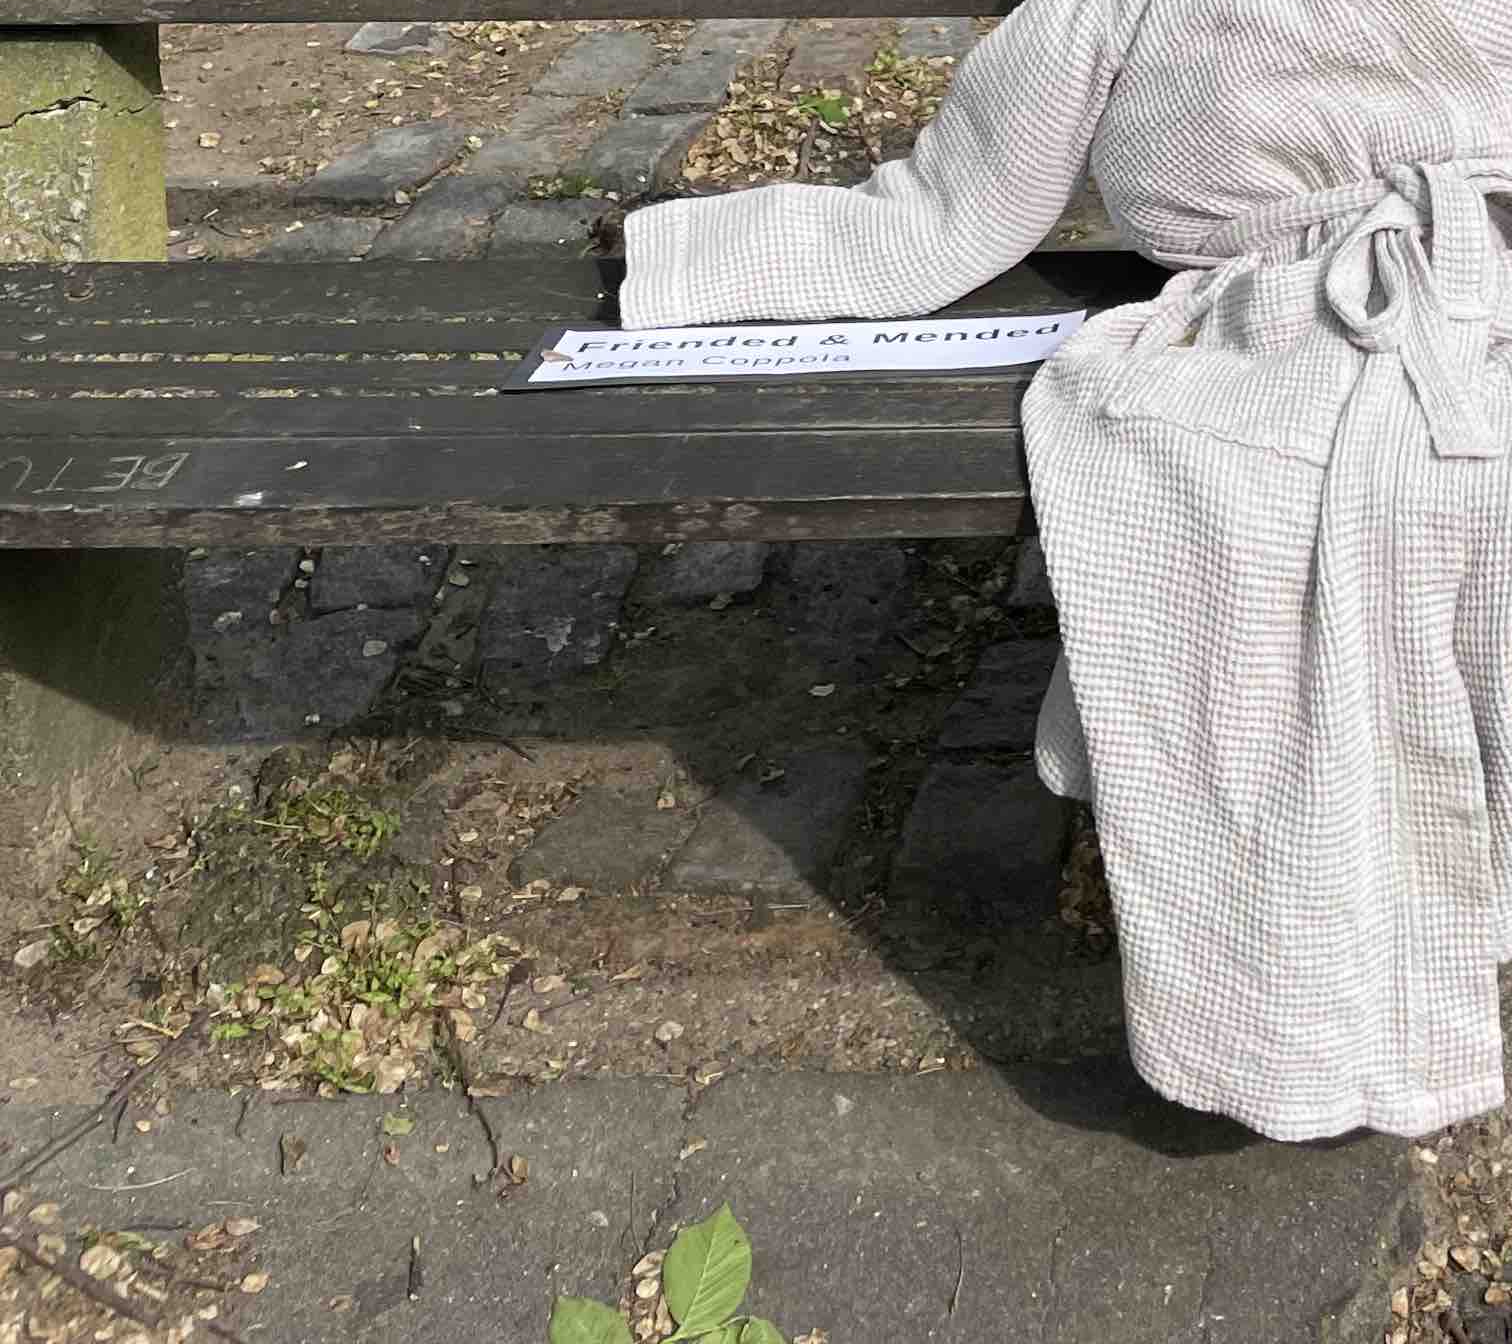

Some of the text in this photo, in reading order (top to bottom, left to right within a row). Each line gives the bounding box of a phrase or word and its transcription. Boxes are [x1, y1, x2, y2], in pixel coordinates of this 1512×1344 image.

[576, 323, 1061, 353] Friended & Mended
[562, 354, 851, 371] Megan Coppola
